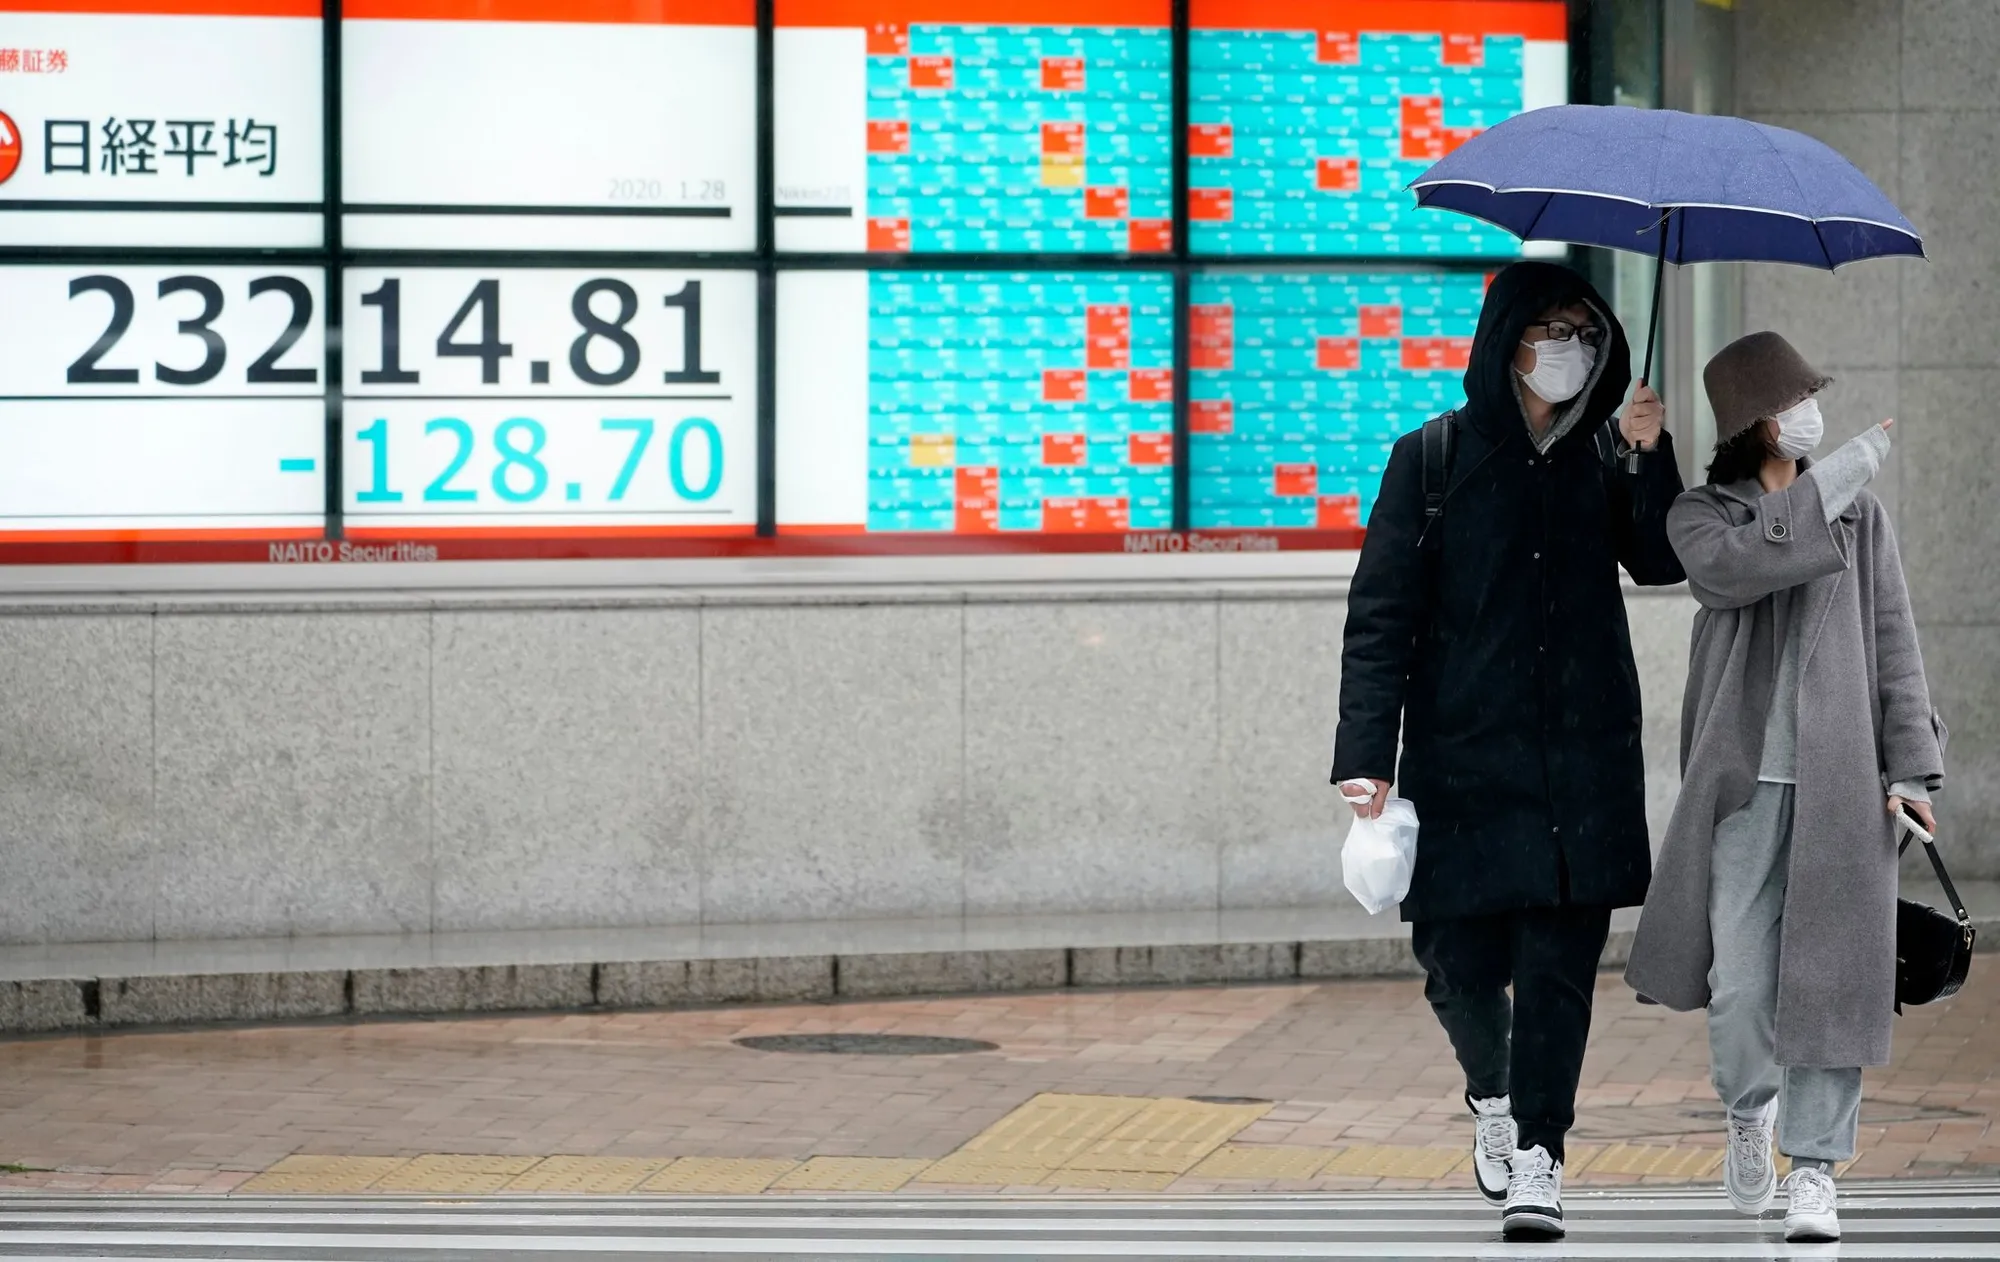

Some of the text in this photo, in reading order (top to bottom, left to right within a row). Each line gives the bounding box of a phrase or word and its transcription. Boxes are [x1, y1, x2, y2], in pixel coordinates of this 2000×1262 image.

[45, 117, 277, 177] 日経平均
[67, 275, 719, 385] 23214.81
[268, 541, 438, 562] NAITO Securities
[1124, 533, 1279, 553] NAITO Securities
